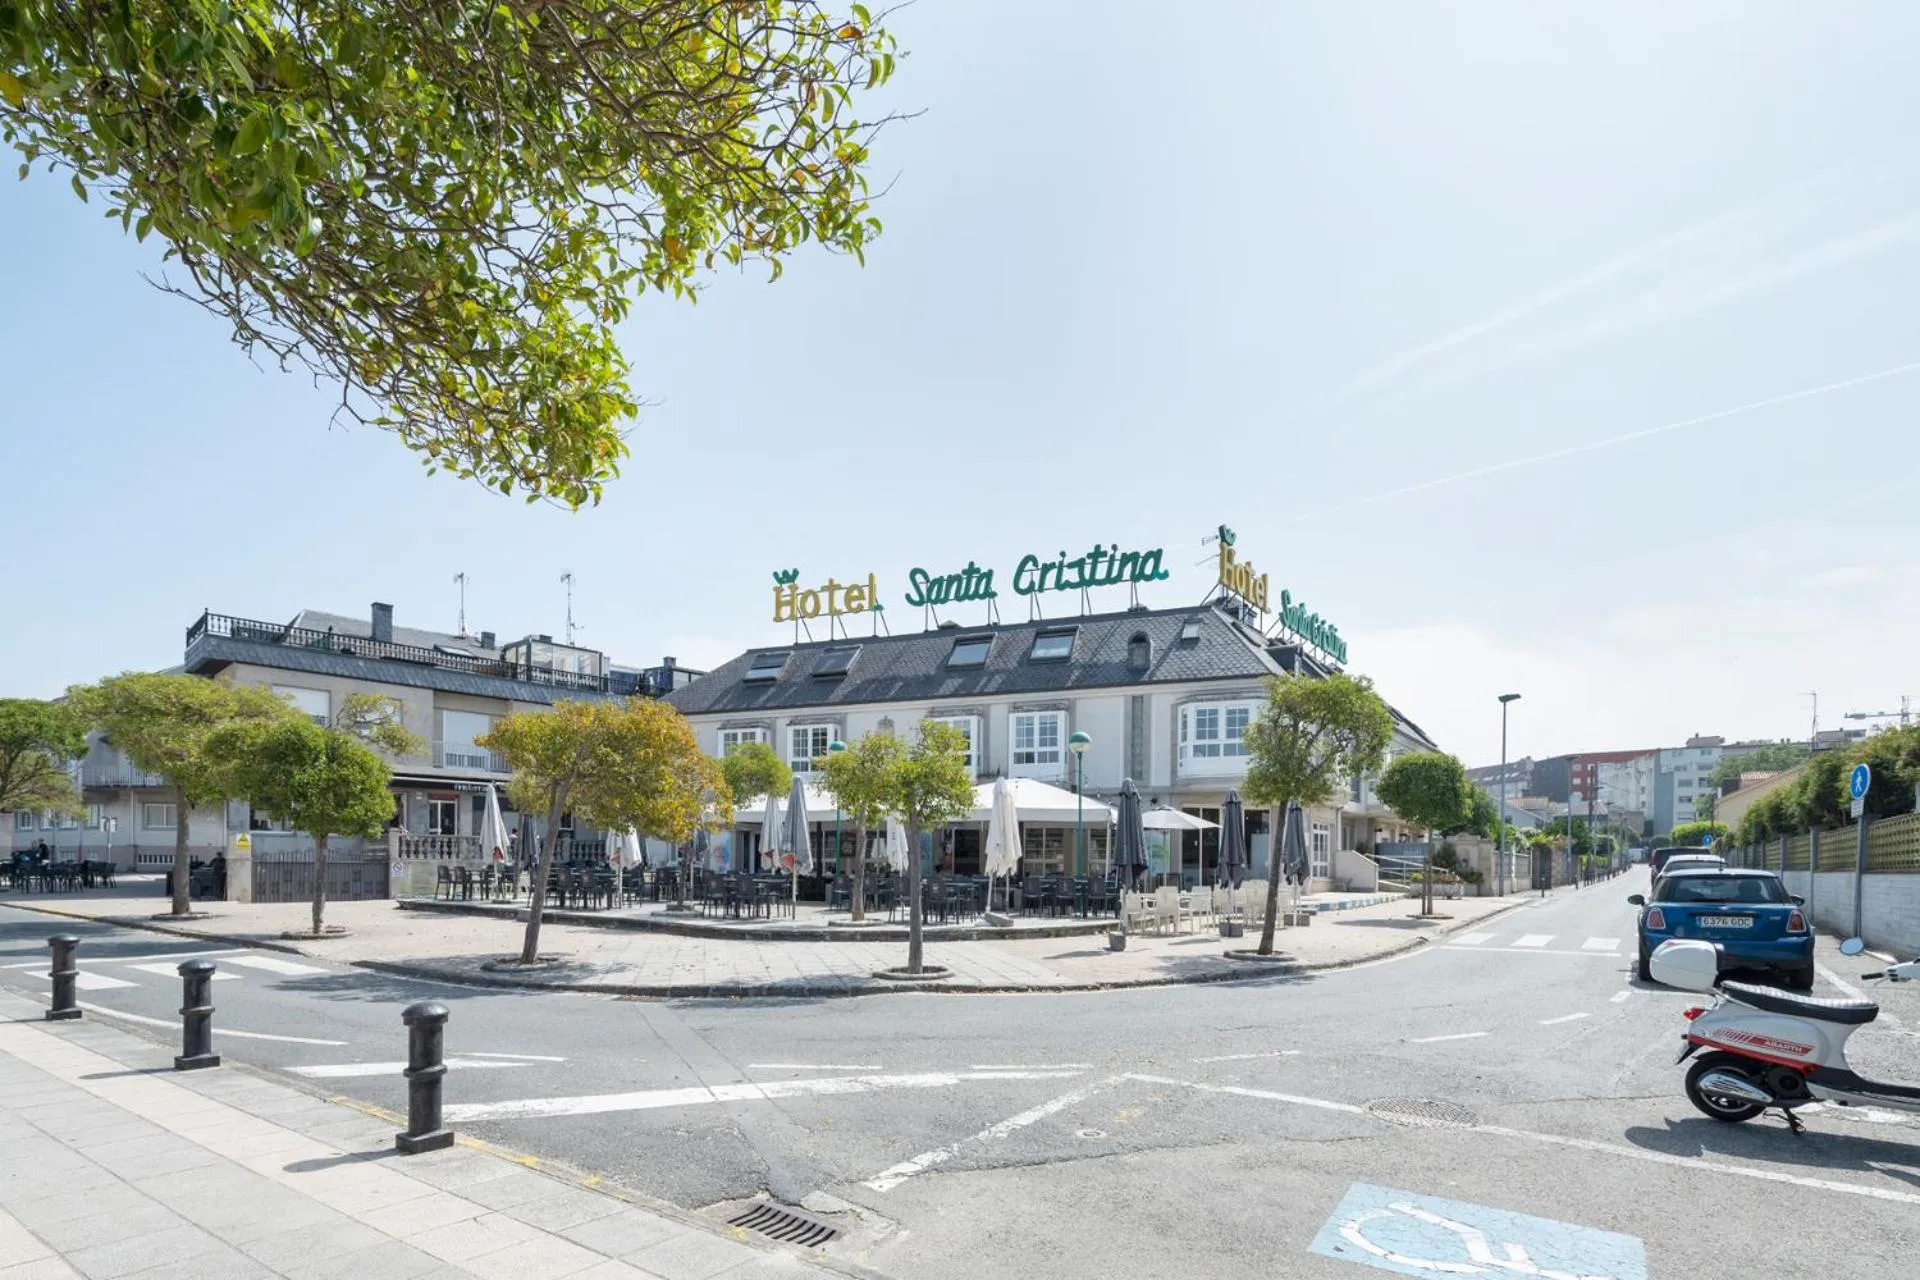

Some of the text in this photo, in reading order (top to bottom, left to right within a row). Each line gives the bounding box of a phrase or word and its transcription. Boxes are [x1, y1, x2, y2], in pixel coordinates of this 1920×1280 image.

[772, 543, 1170, 623] Hotel Santa Cristina
[1763, 1039, 1803, 1053] ABARTH
